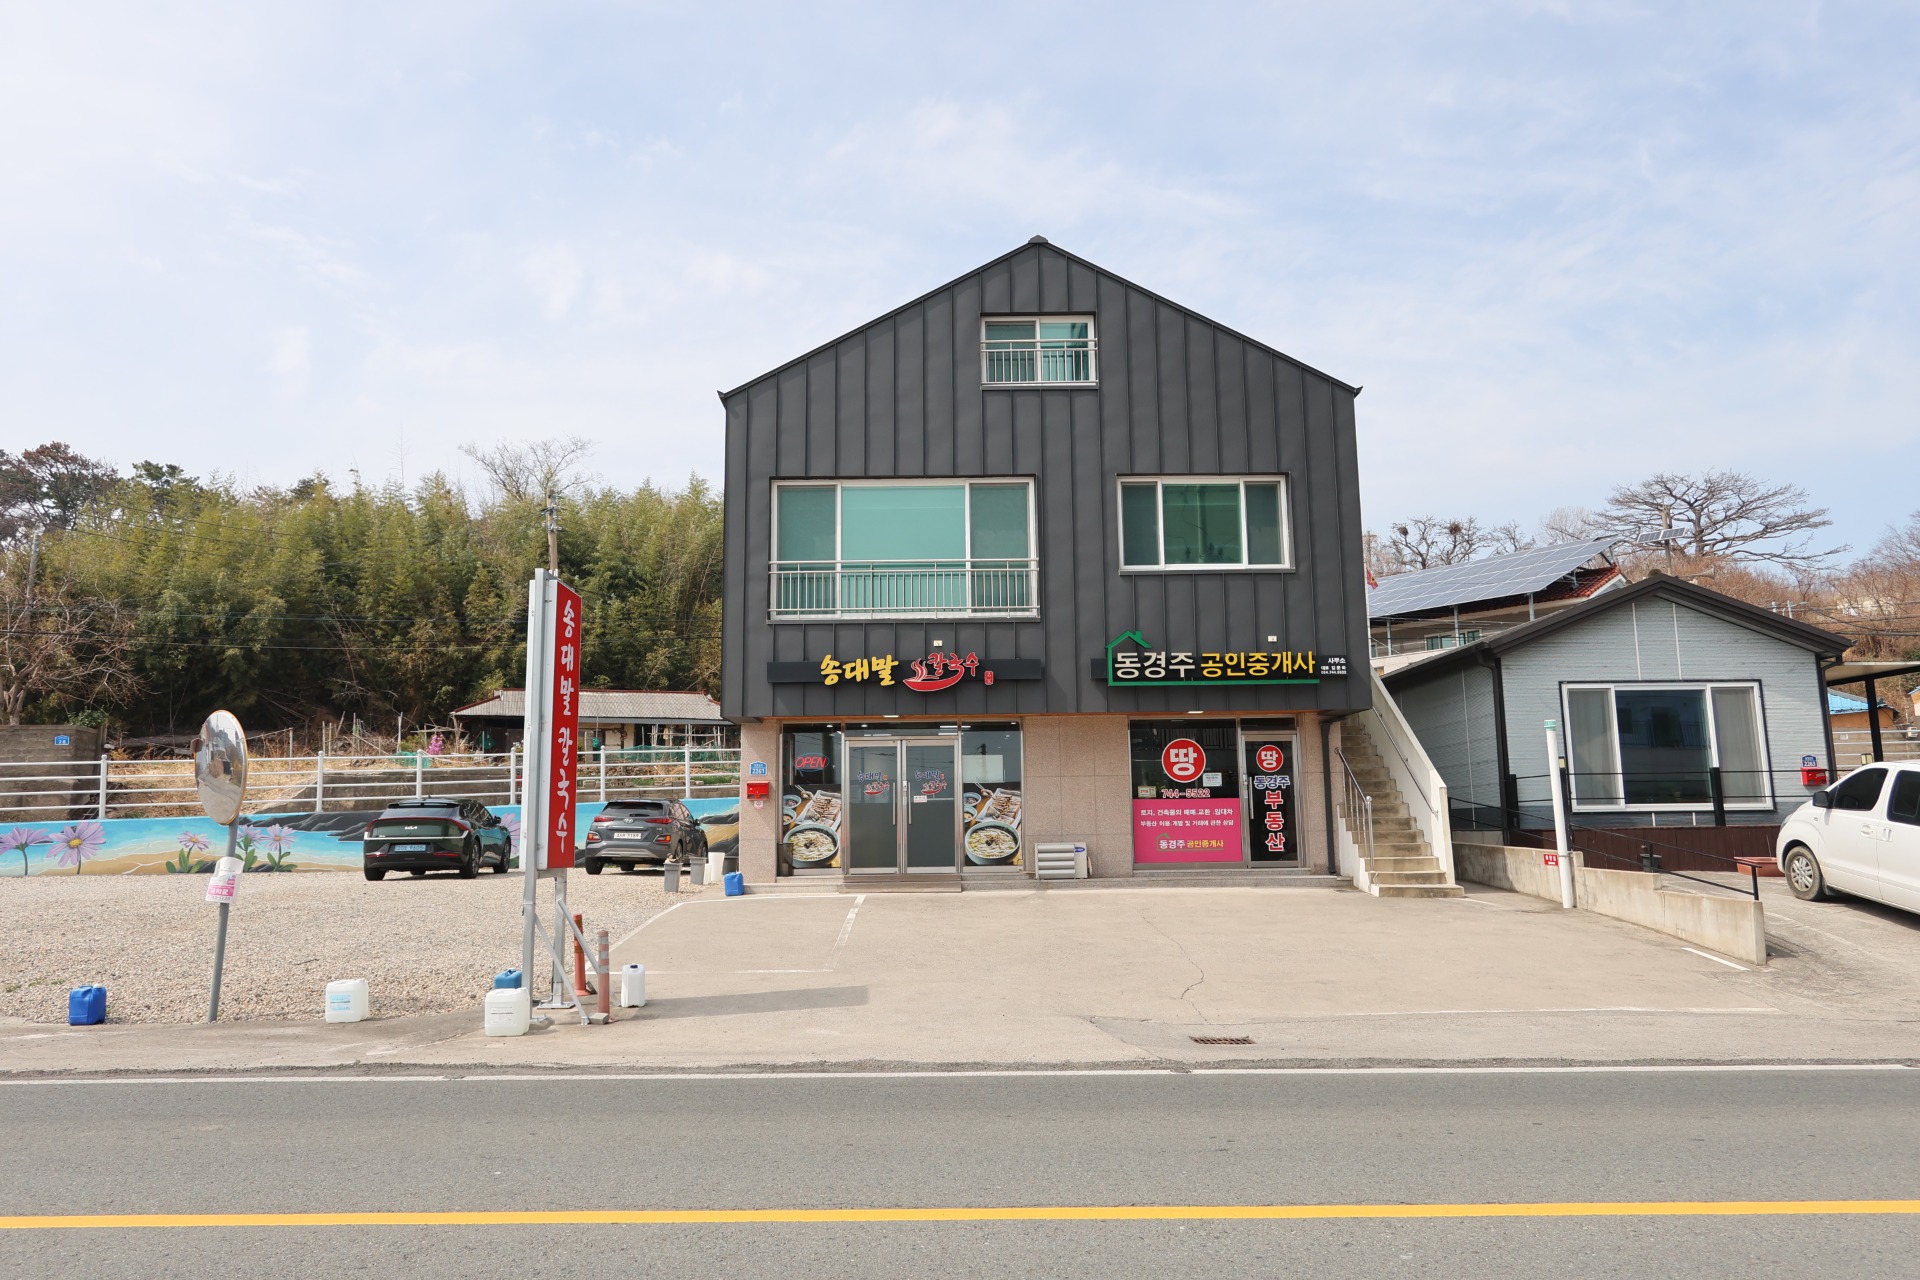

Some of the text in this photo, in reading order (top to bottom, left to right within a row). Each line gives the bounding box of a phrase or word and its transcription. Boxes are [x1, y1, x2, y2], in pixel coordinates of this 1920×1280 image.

[820, 652, 980, 686] 송대말 칼국수
[1114, 652, 1315, 678] 동경주 공인중개사
[795, 756, 827, 768] OPEN
[1170, 747, 1197, 775] 땅
[1261, 750, 1279, 768] 땅
[556, 727, 573, 853] 칼국수
[1162, 788, 1211, 798] 744-5522
[1254, 776, 1290, 789] 동경주
[1265, 791, 1284, 852] 부동산
[1159, 839, 1224, 849] 동경주 공인중개사
